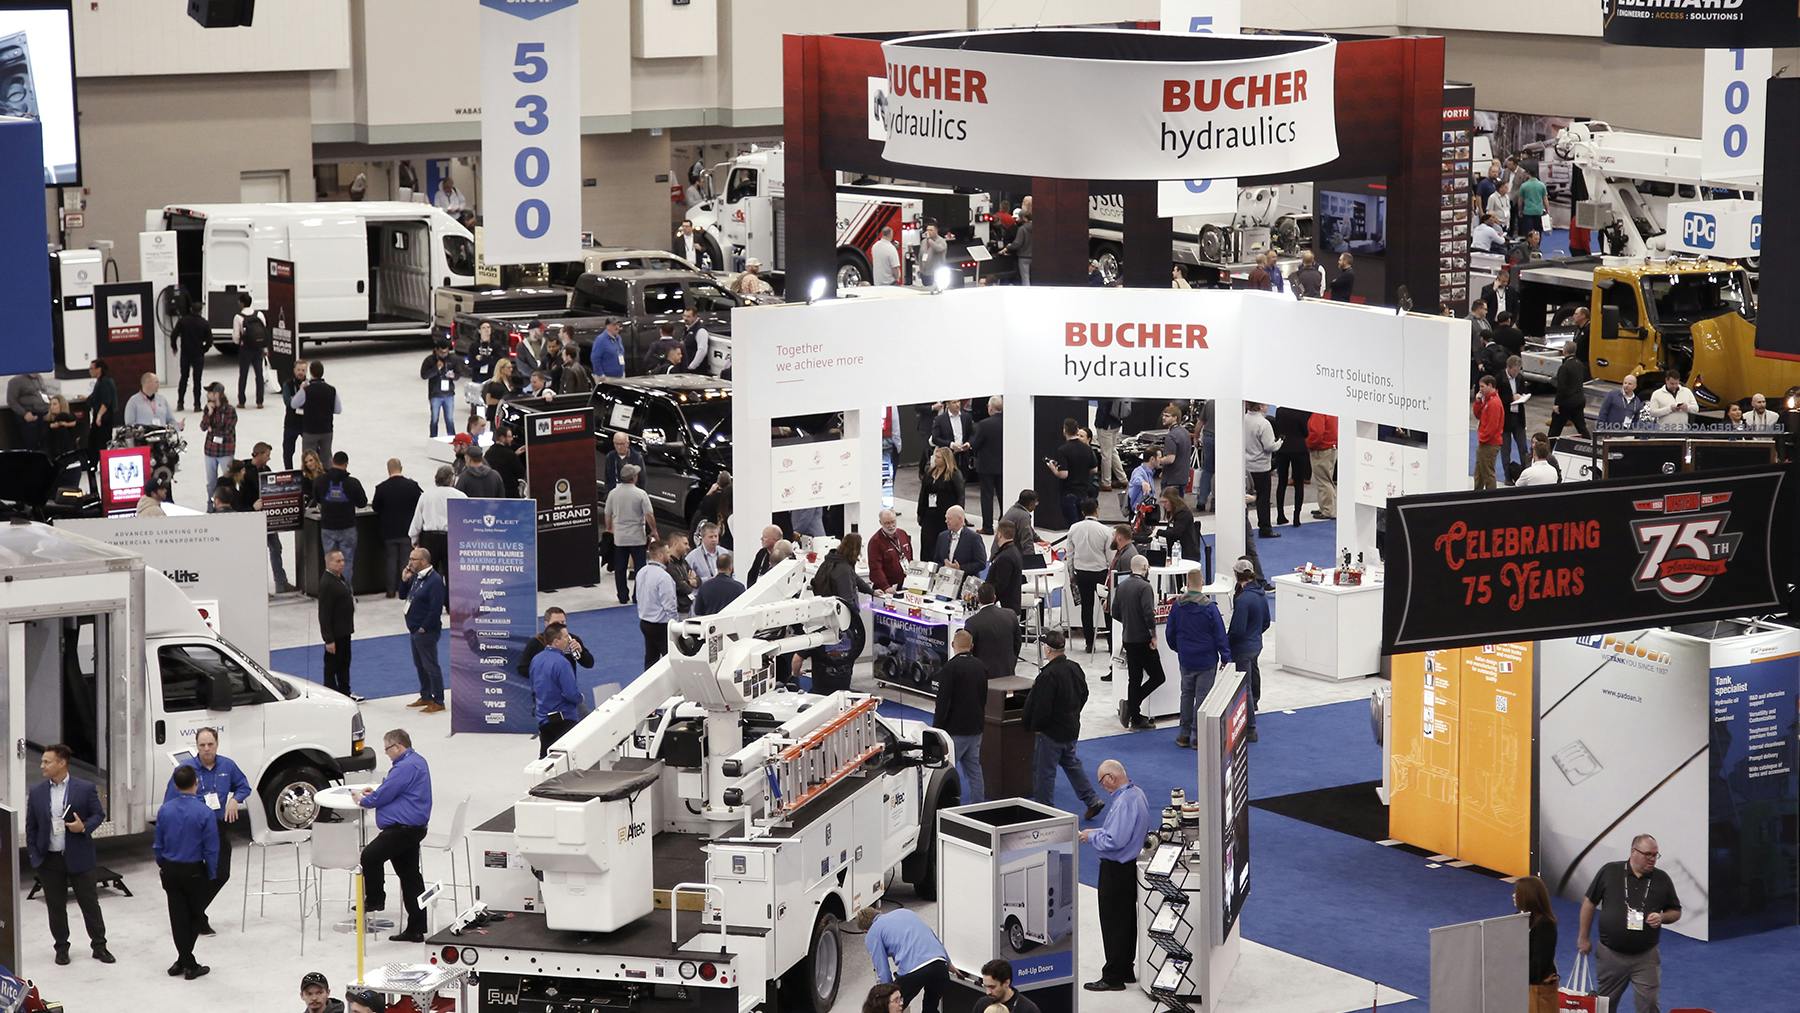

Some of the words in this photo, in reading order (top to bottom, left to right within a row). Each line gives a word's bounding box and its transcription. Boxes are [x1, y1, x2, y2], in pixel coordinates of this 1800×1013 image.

[1163, 69, 1308, 112] BUCHER
[1161, 116, 1296, 159] hydraulics
[1684, 214, 1715, 246] PPG
[1065, 322, 1209, 349] BUCHER
[776, 344, 824, 358] Together
[776, 362, 792, 372] we
[794, 357, 833, 370] achieve
[836, 354, 864, 366] more
[1065, 354, 1190, 382] hydraulics
[1316, 364, 1344, 379] Smart
[1346, 368, 1394, 387] Solutions.
[1346, 386, 1386, 403] Superior
[553, 418, 582, 426] RAM
[552, 507, 591, 521] BRAND
[115, 530, 154, 538] ADVANCED
[156, 528, 191, 536] LIGHTING
[155, 536, 220, 544] TRANSPORTATION
[459, 541, 494, 550] SAVING
[497, 542, 524, 550] LIVES
[459, 550, 496, 558] PREVENTING
[497, 550, 524, 558] INJURIES
[460, 564, 480, 572] MORE
[482, 564, 525, 572] PRODUCTIVE
[1462, 575, 1492, 606] 75
[1715, 675, 1732, 686] Tank
[1715, 683, 1748, 697] specialist
[627, 822, 646, 841] Altec
[1018, 967, 1037, 977] Roll-Up
[1038, 964, 1053, 973] Doors
[1, 980, 18, 1000] Rite
